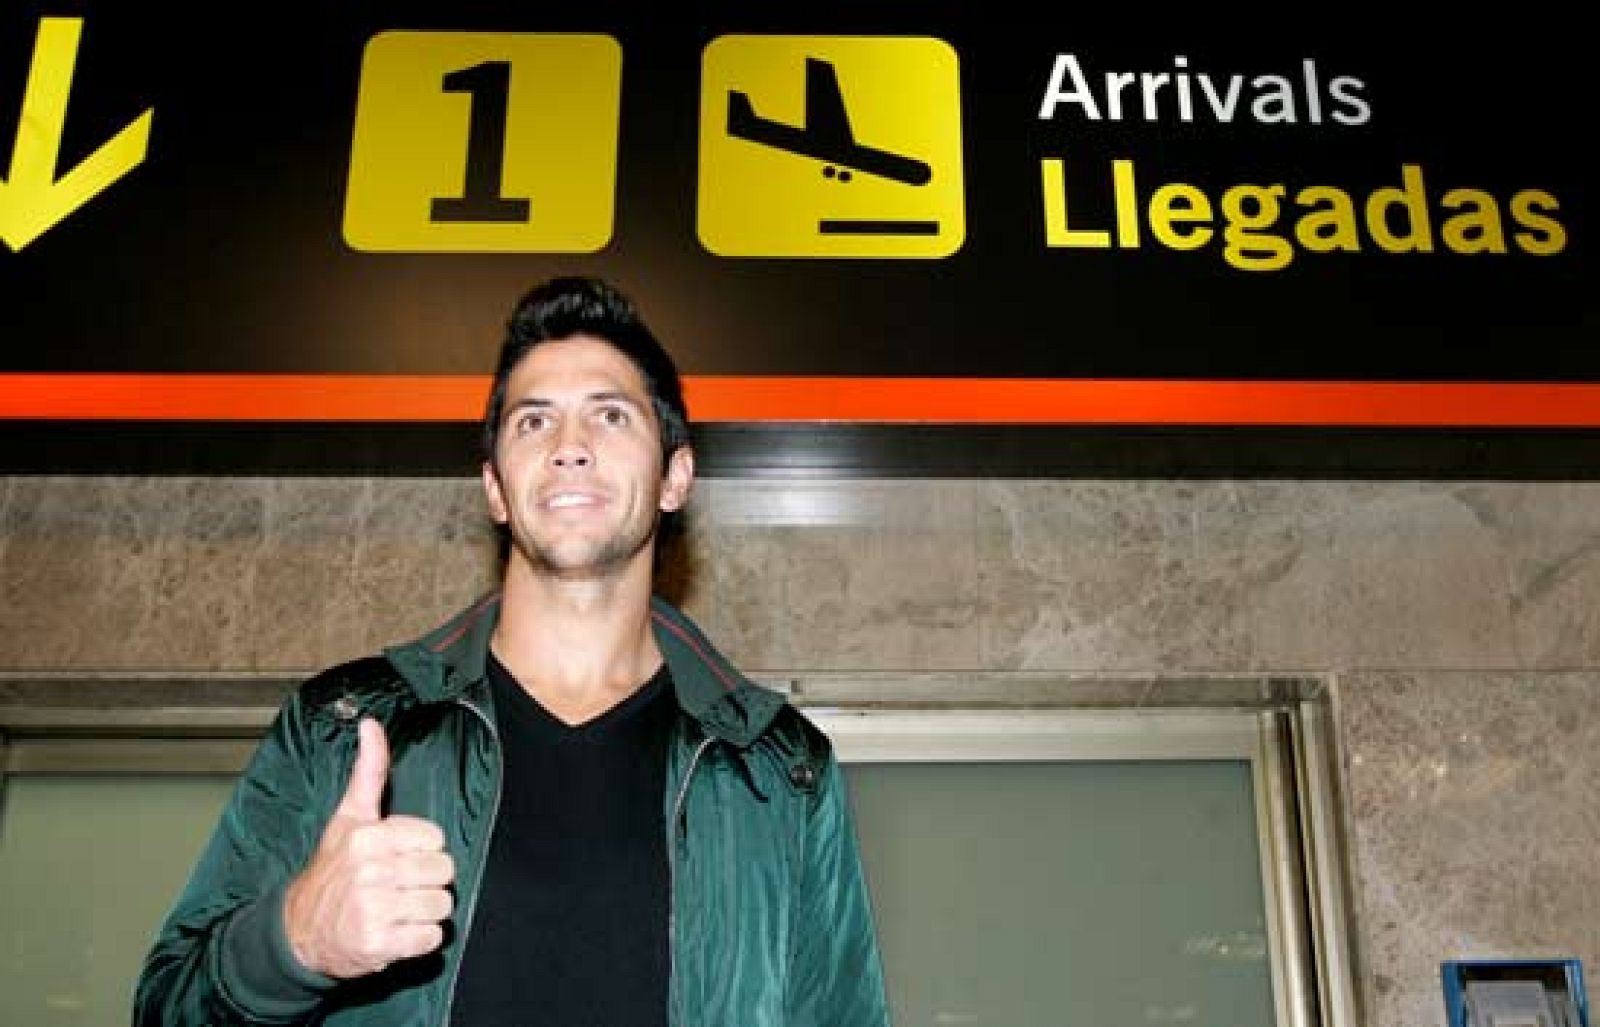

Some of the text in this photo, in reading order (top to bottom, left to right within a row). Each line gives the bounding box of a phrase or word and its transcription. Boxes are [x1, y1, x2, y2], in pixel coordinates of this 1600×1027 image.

[430, 60, 530, 223] 1
[1038, 53, 1372, 126] Arrivals
[1041, 158, 1567, 272] Llegadas
